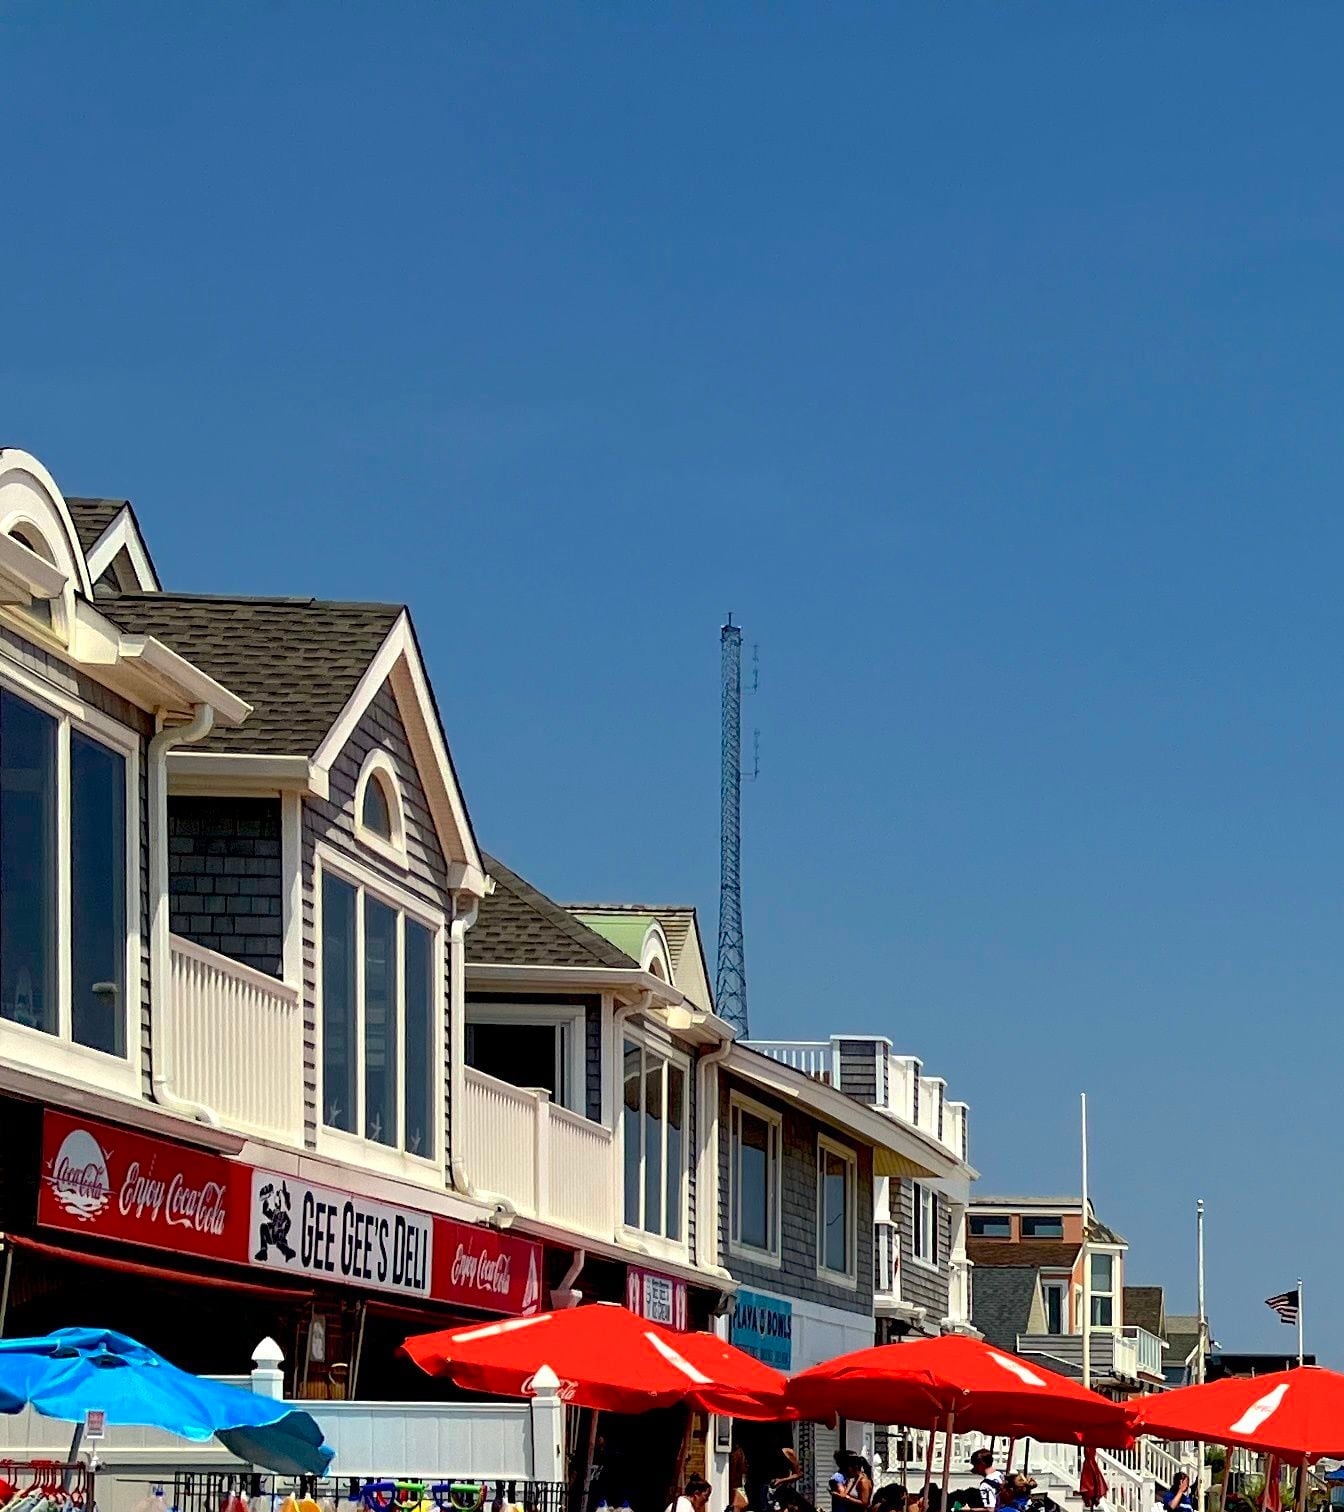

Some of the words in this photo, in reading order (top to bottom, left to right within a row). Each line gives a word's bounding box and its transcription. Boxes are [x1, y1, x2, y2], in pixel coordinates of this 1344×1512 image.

[119, 1161, 166, 1222] Enjoy
[165, 1173, 226, 1236] Coca-Cola
[300, 1190, 338, 1272] GEE
[341, 1200, 389, 1283] GEE'S
[392, 1214, 428, 1290] DELI
[451, 1243, 477, 1291] Enjoy
[732, 1303, 758, 1332] PLAYA
[767, 1310, 792, 1340] BOWLS
